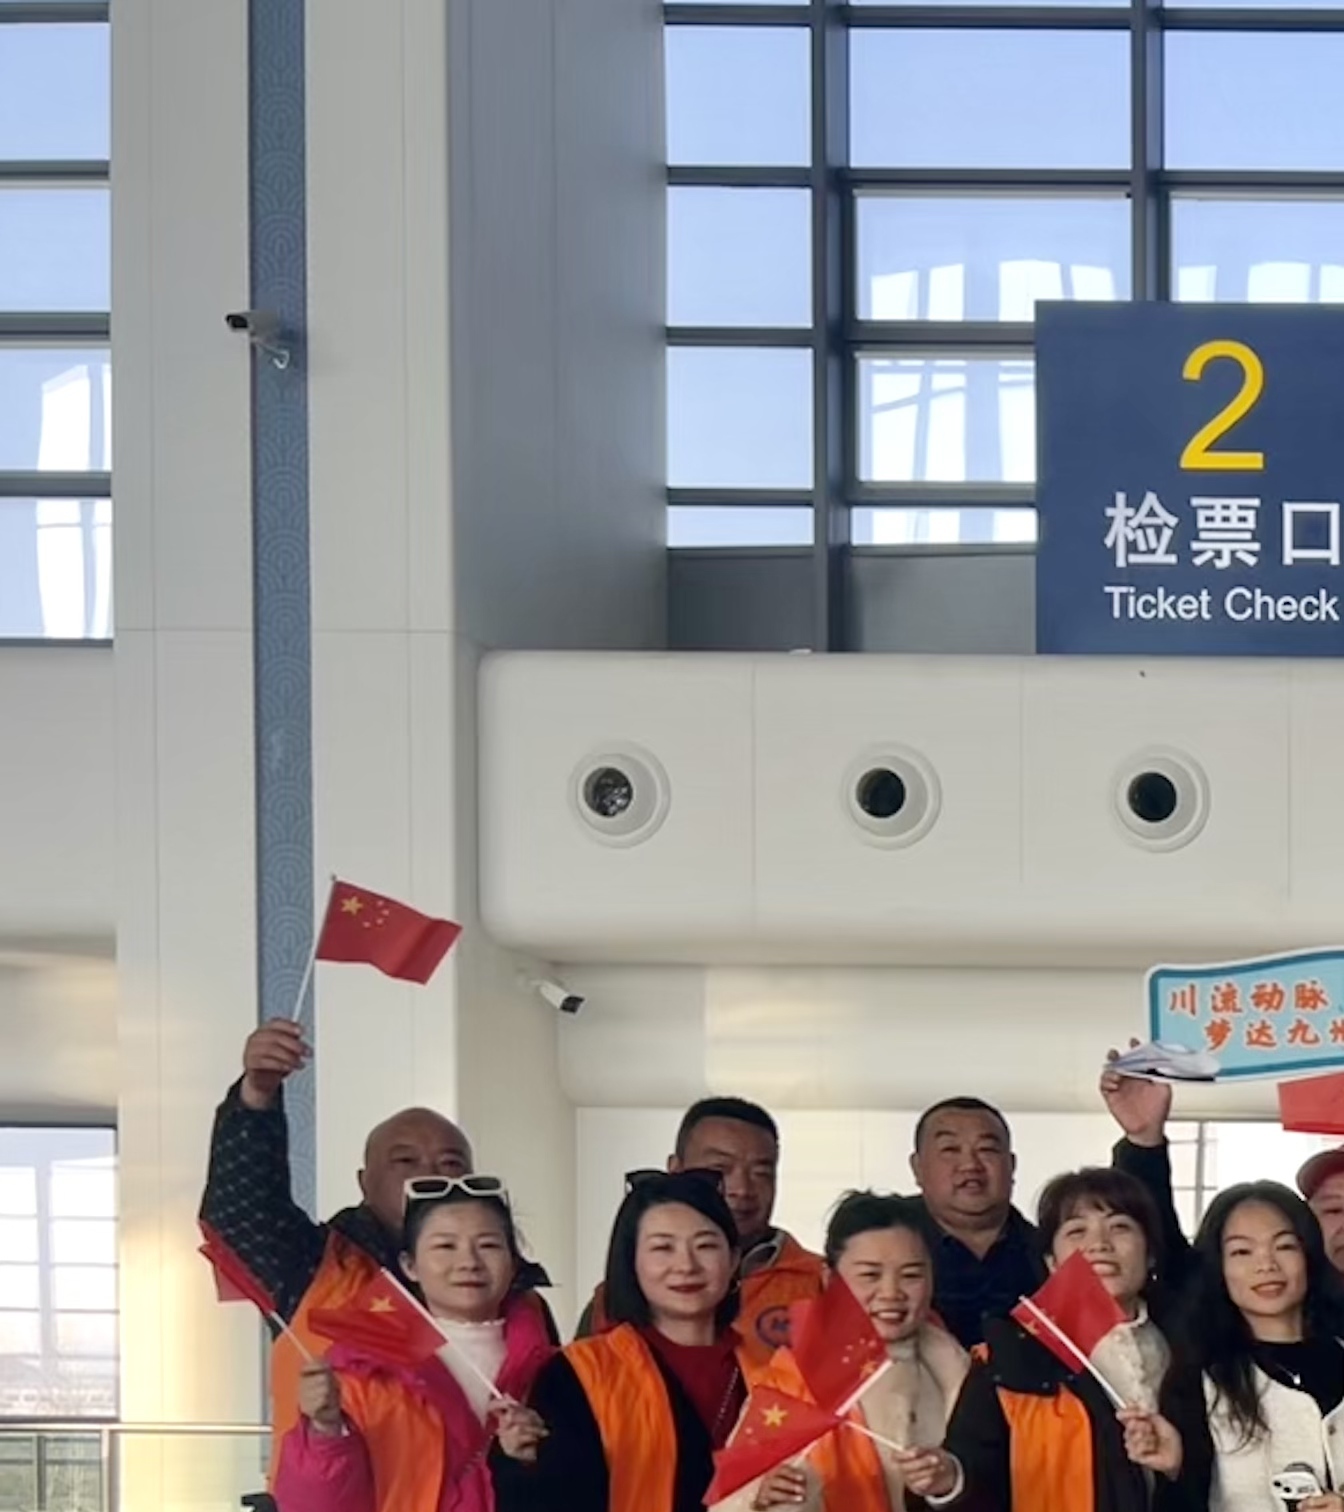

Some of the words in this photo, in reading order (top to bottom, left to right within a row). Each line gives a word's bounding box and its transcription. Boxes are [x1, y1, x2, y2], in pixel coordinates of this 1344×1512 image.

[1180, 339, 1264, 469] 2
[1104, 492, 1340, 568] 检票口
[1104, 586, 1211, 620] Ticket
[1225, 587, 1339, 621] Check
[1169, 981, 1328, 1015] 川流动脉
